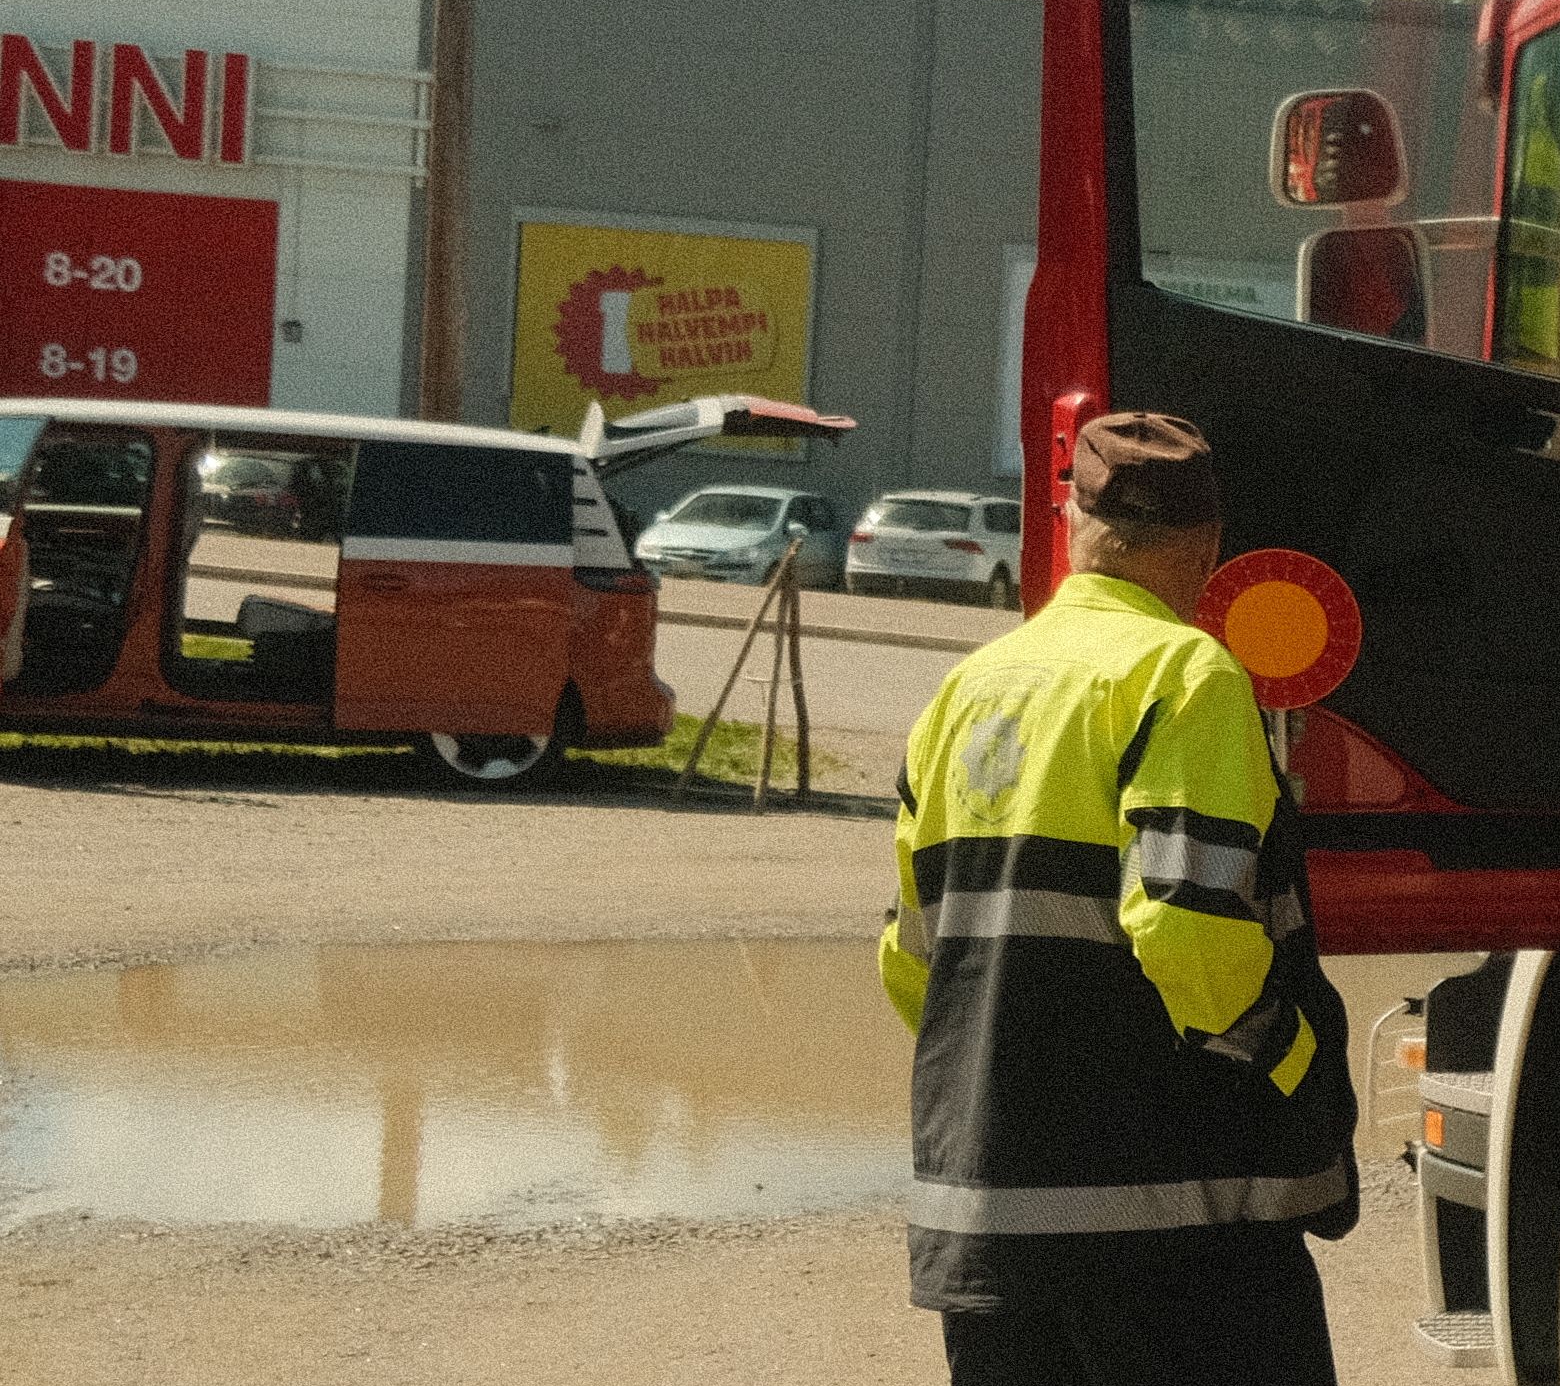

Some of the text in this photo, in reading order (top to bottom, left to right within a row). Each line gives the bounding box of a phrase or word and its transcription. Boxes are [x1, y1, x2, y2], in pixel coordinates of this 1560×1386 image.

[44, 251, 142, 293] 8-20
[657, 287, 741, 315] HALPA
[637, 311, 768, 344] HALVEMPI
[41, 343, 138, 383] 8-19
[660, 340, 754, 369] HALVIN
